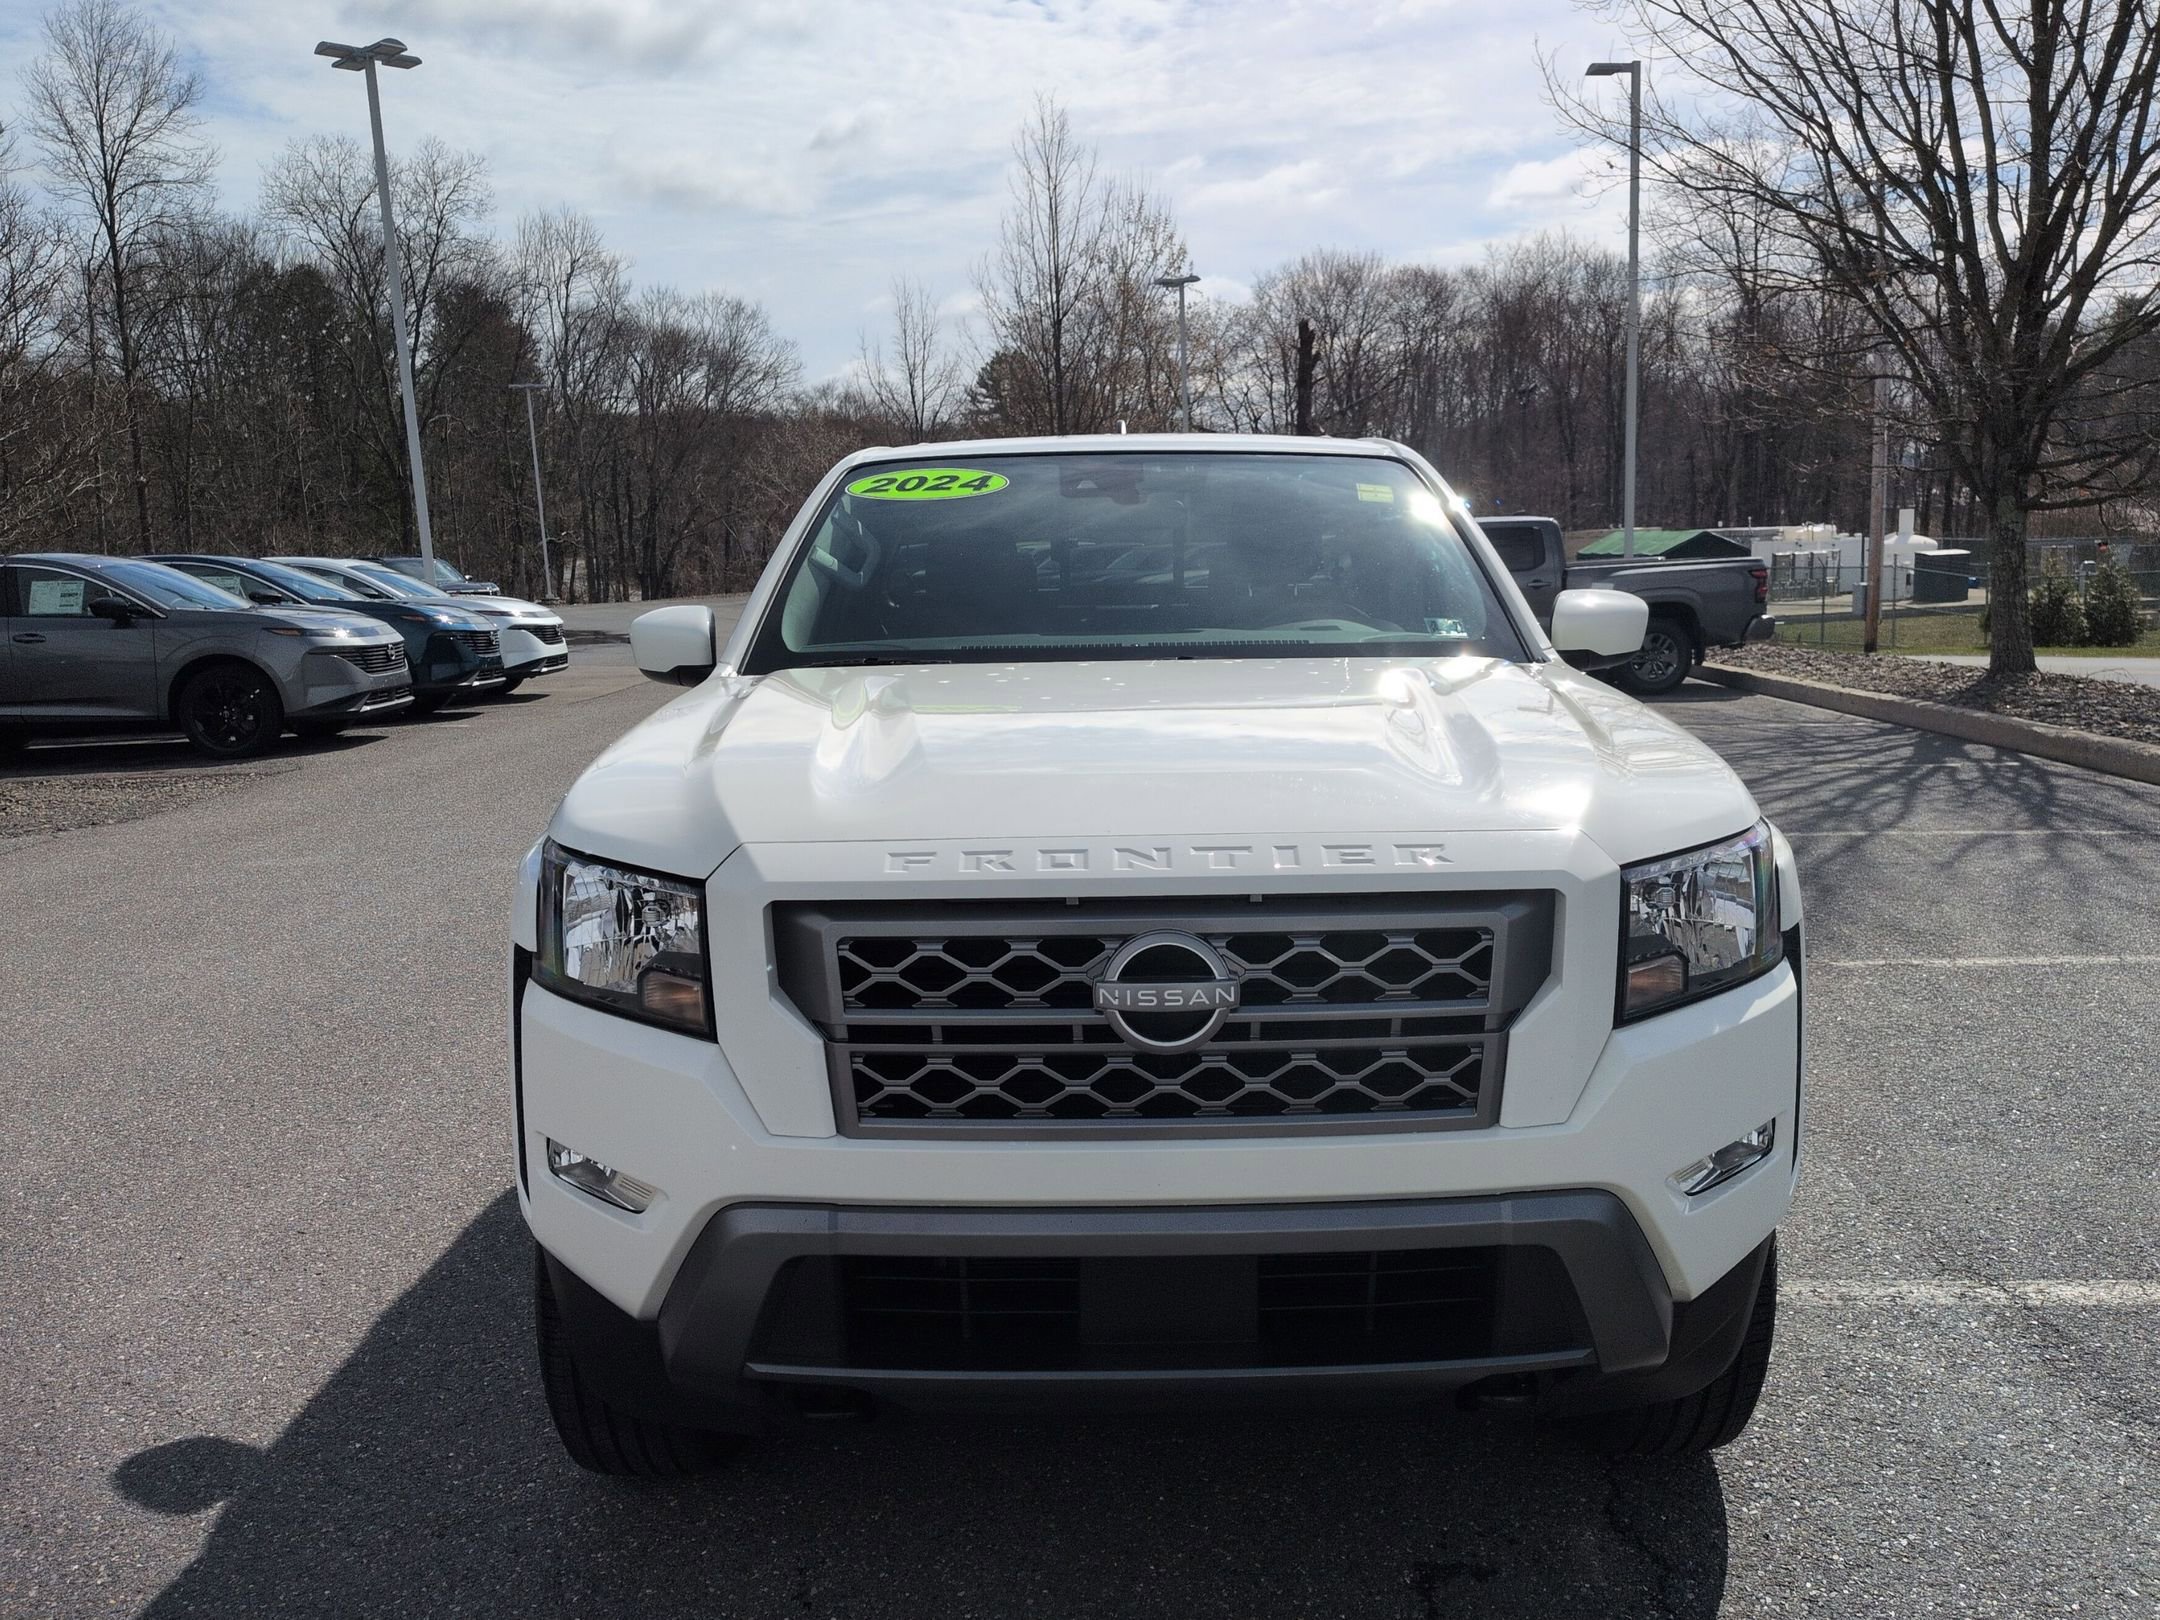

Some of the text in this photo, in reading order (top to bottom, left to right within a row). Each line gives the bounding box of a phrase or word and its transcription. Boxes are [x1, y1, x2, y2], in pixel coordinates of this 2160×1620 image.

[860, 475, 993, 493] 2024
[883, 844, 1454, 873] FRONTIER
[1100, 986, 1235, 1006] NISSAN
